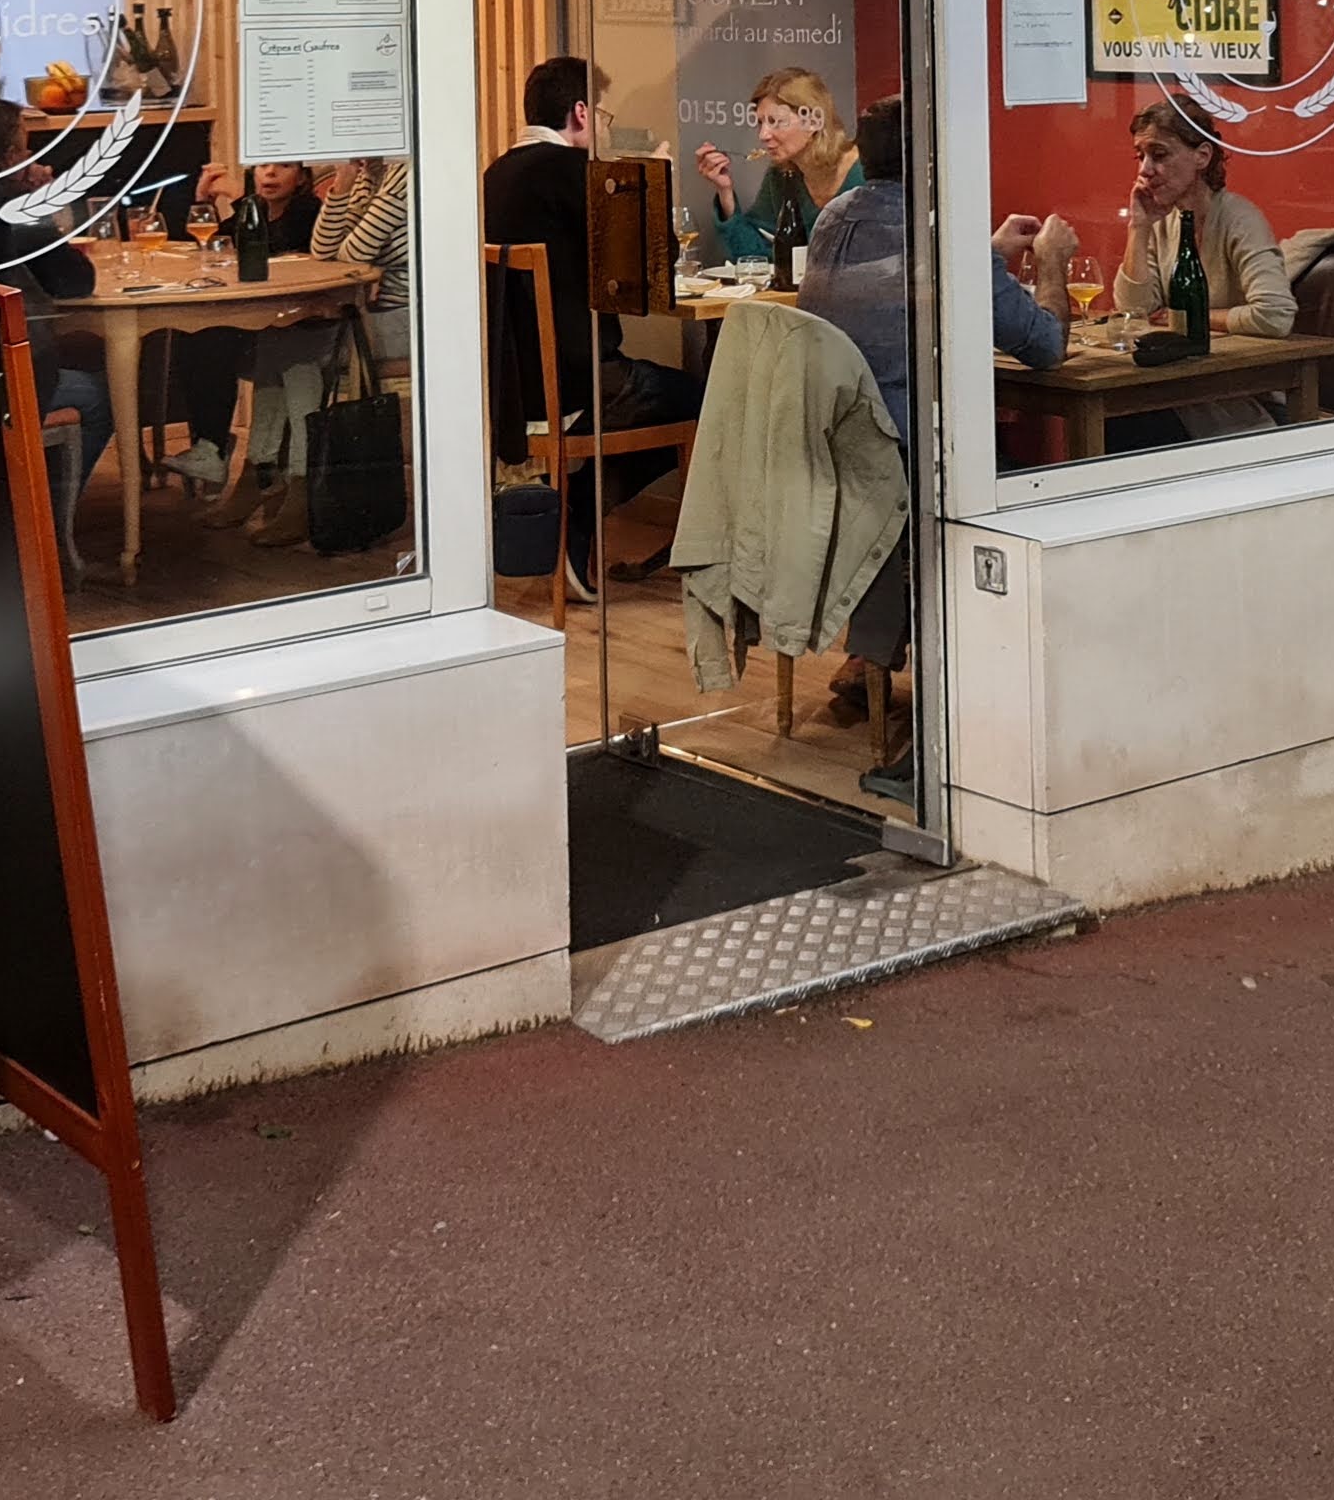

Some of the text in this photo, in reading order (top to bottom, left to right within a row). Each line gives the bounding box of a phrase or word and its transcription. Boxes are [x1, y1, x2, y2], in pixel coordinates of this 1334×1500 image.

[744, 26, 767, 43] au
[773, 13, 842, 45] samedi
[1103, 42, 1142, 57] VOUS
[1211, 43, 1262, 59] VIEUX
